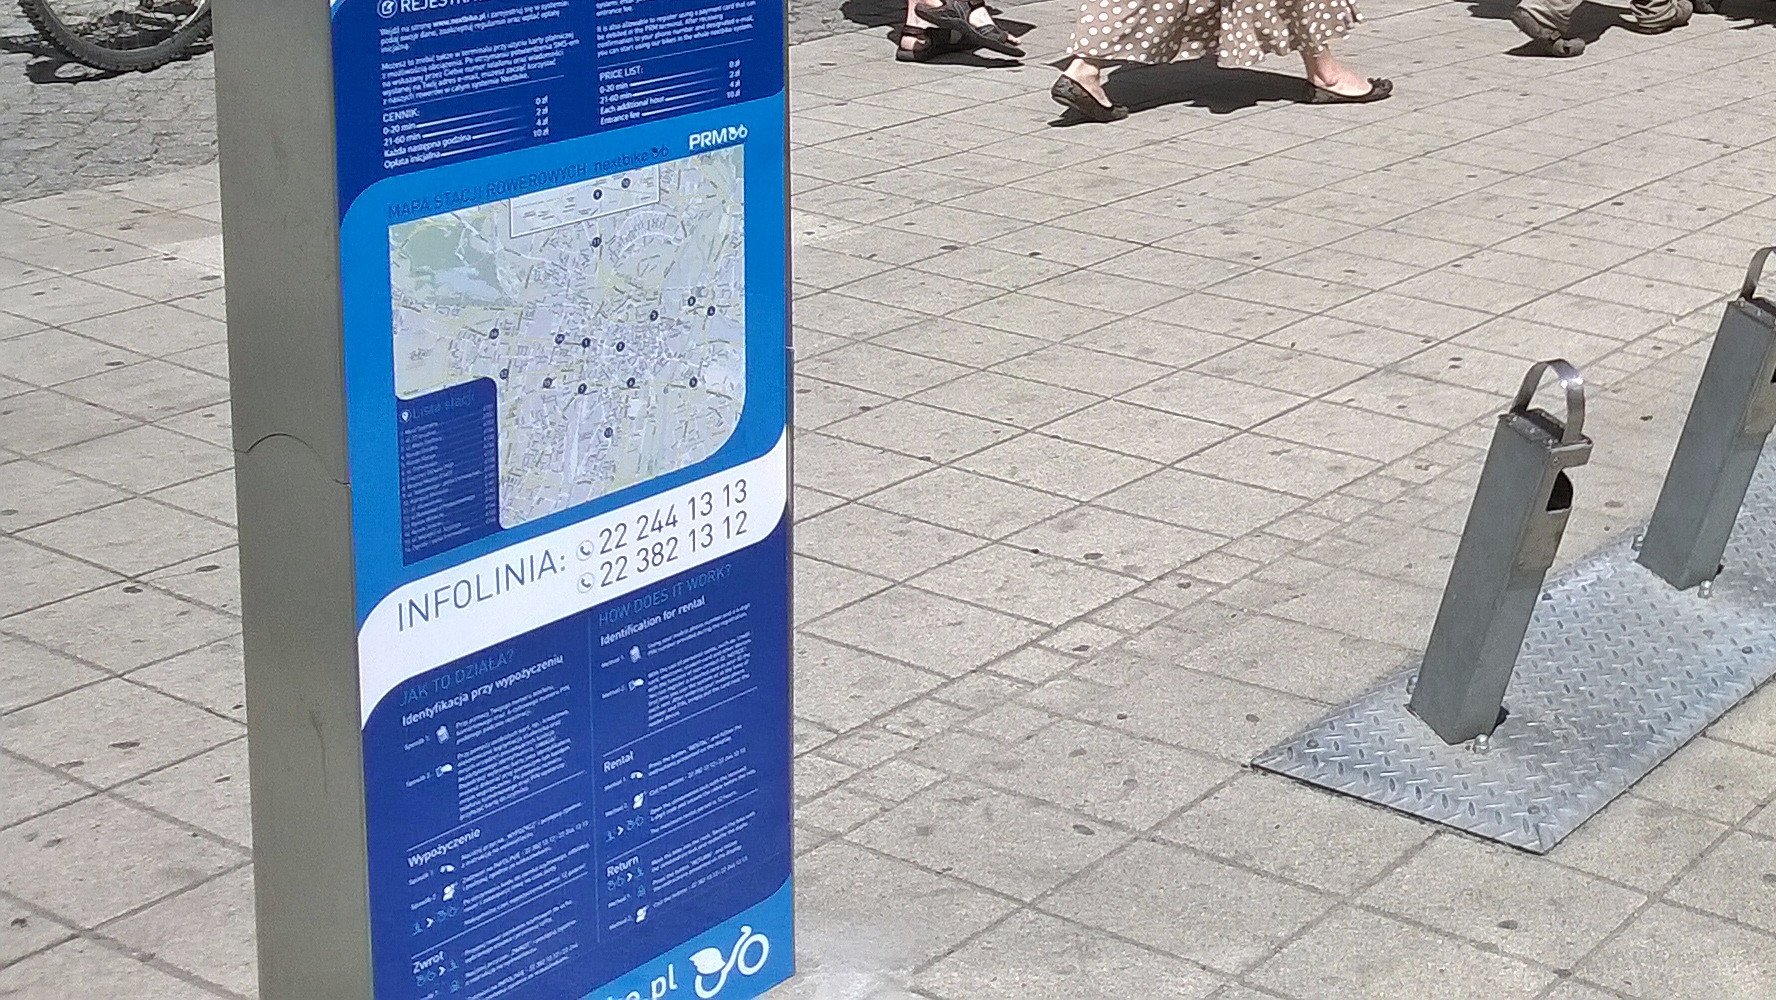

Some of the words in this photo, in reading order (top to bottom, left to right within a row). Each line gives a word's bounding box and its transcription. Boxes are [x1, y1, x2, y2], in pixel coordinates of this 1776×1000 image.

[599, 69, 624, 82] PRICE
[383, 124, 400, 135] 0-20
[383, 135, 405, 147] 21-60
[406, 132, 422, 142] min
[688, 129, 727, 150] PRM
[388, 197, 432, 220] MAPA
[434, 185, 483, 211] STACJI
[485, 164, 587, 200] ROWEROWYCH
[594, 150, 649, 175] nextbike
[397, 549, 567, 633] INFOLINIA:
[599, 525, 628, 556] 22
[636, 504, 679, 541] 244
[687, 490, 713, 520] 13
[722, 478, 748, 508] 13
[600, 557, 628, 588] 22
[636, 536, 679, 574] 382
[687, 522, 713, 552] 13
[722, 510, 748, 540] 12
[599, 604, 630, 627] HOW
[633, 587, 668, 615] DOES
[670, 582, 683, 602] IT
[685, 563, 733, 595] WORK?
[600, 613, 660, 647] Identification
[663, 604, 679, 623] for
[680, 595, 706, 619] rental
[400, 683, 429, 707] JAK
[402, 694, 469, 728] Identyfikacja
[470, 681, 495, 706] przy
[603, 750, 635, 773] Rental
[606, 853, 640, 877] Return
[411, 950, 445, 975] Zwrot
